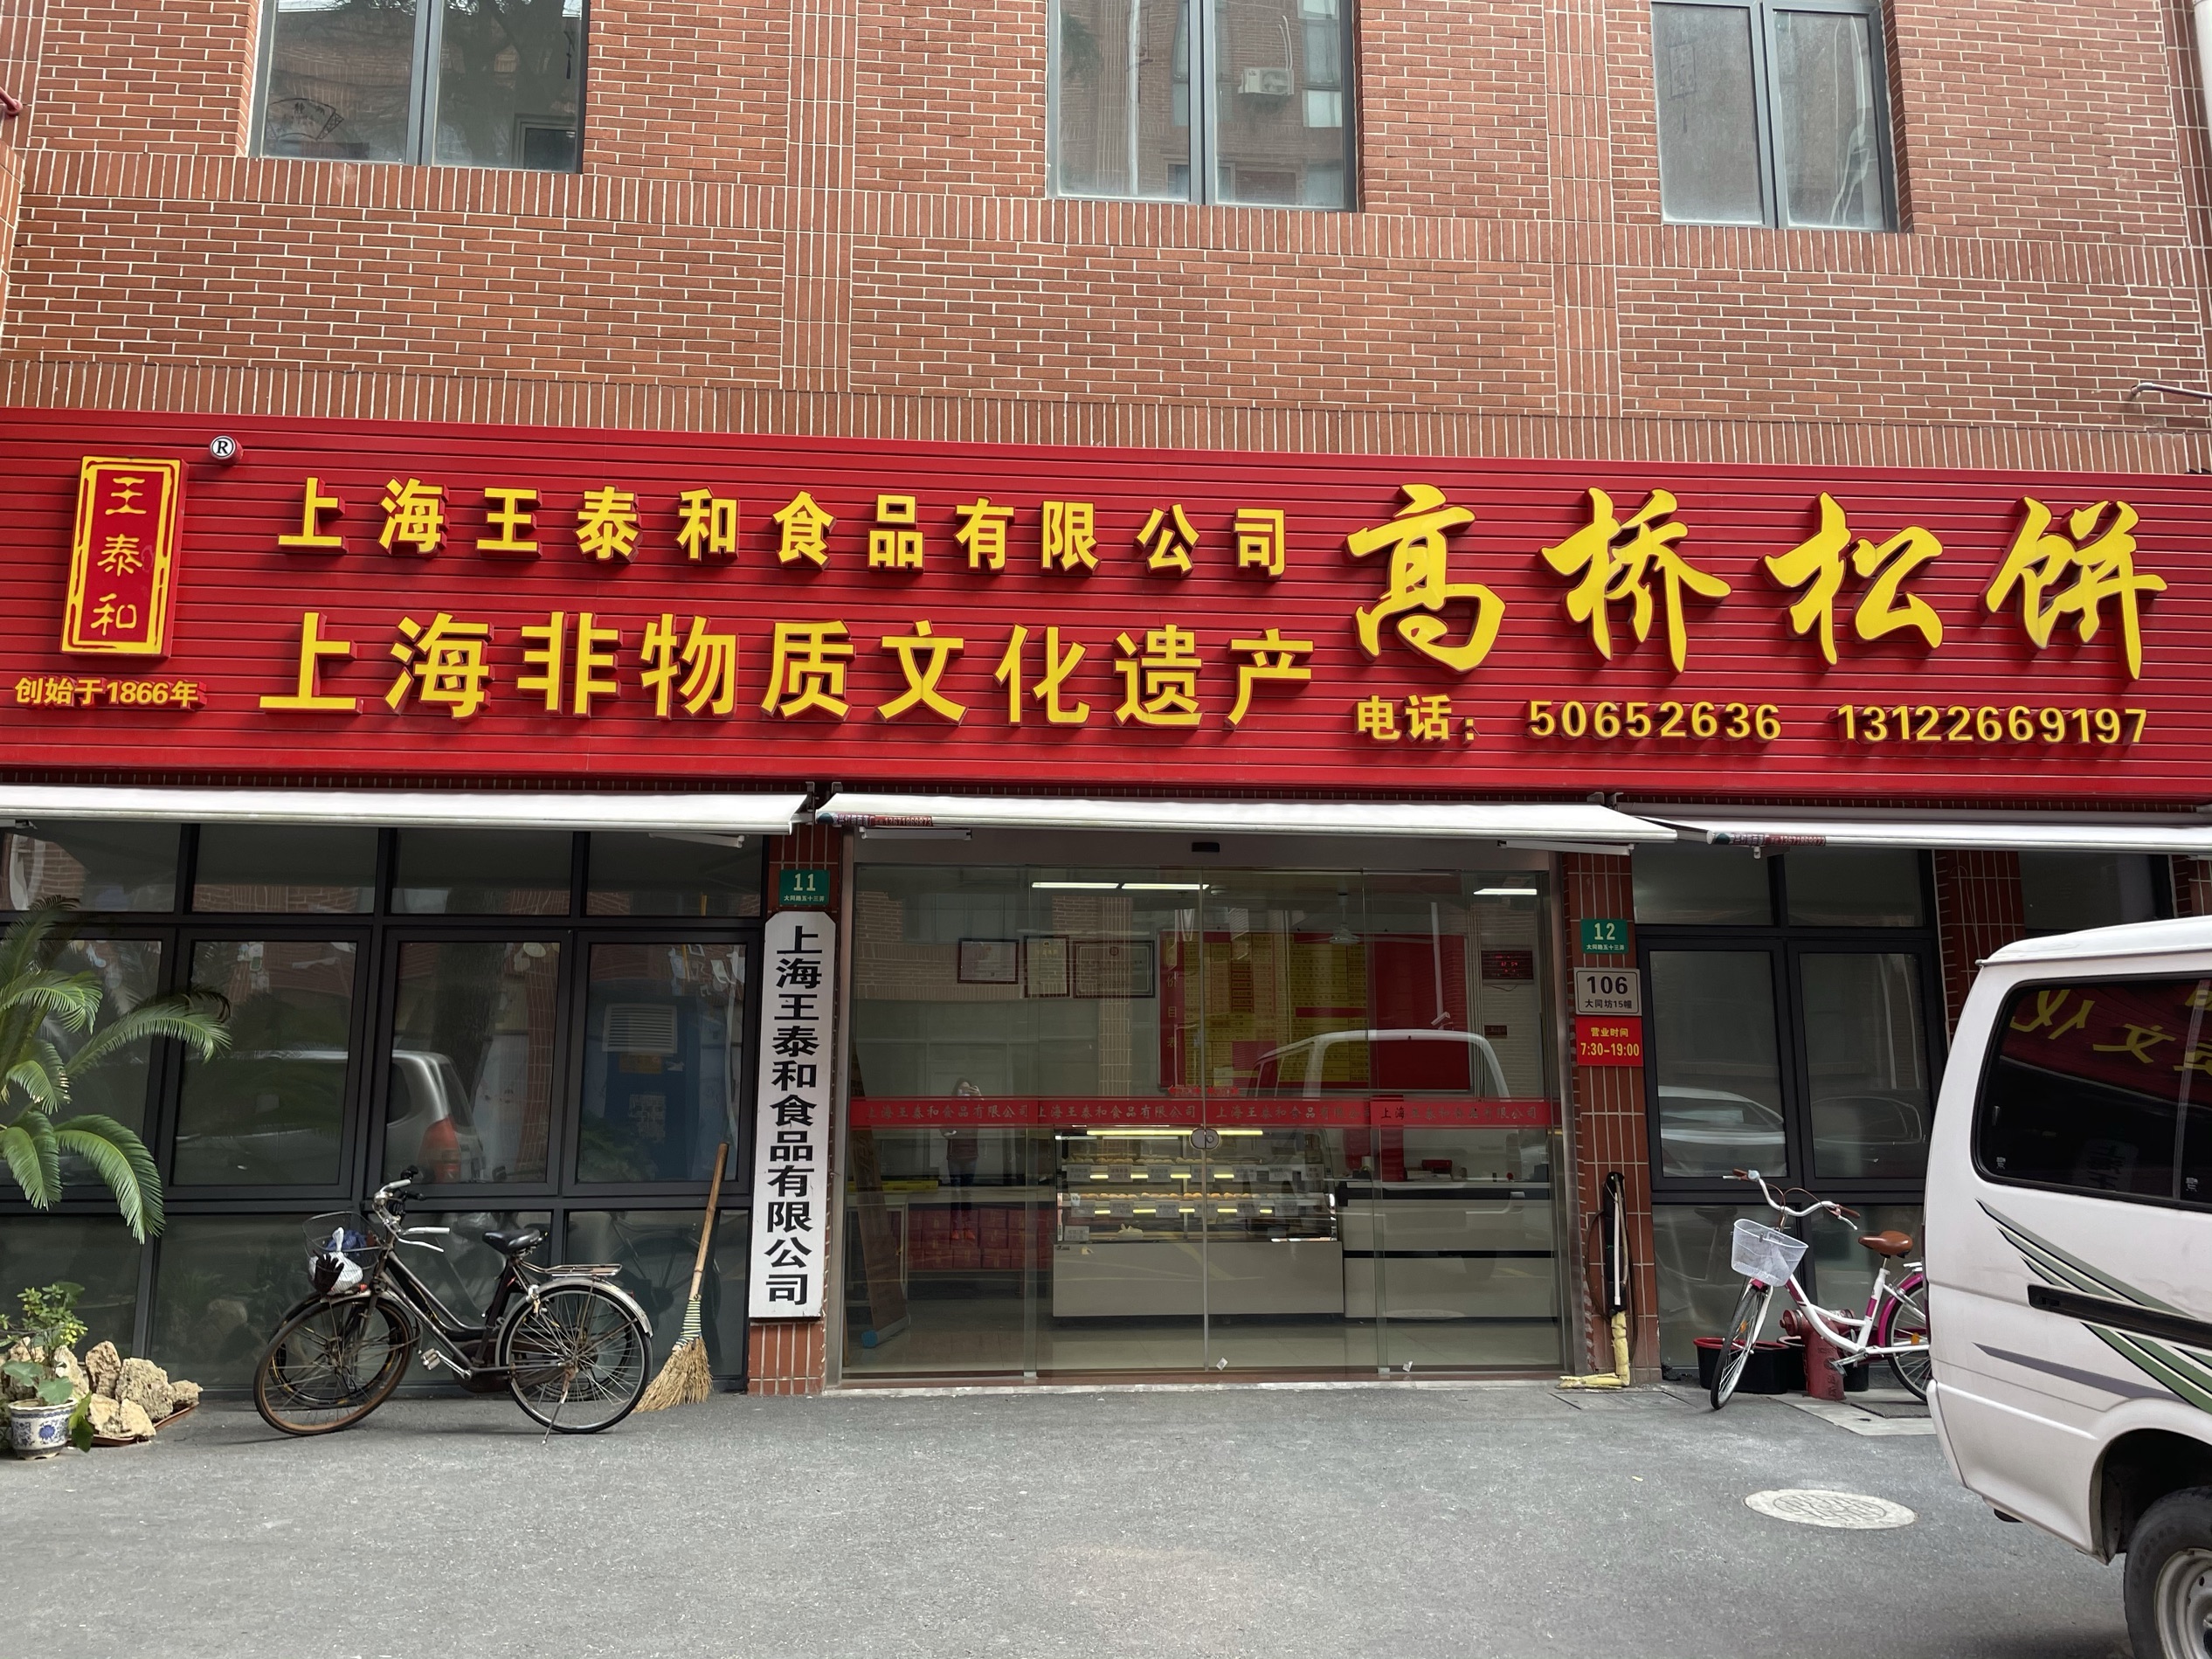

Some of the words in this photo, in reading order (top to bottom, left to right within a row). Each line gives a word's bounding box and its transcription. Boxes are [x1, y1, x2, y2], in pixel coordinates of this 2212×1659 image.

[278, 477, 1286, 578] 上海王泰和食品有限公司
[90, 476, 147, 636] 王泰和
[1346, 483, 2168, 681] 高桥松饼
[259, 612, 1314, 730] 上海非物质文化遗产
[15, 677, 199, 708] 创始于1866年
[1529, 700, 1782, 741] 50652636
[1838, 703, 2147, 744] 13122669197
[793, 873, 816, 891] 11
[1594, 923, 1615, 940] 12
[1586, 976, 1628, 994] 106
[1585, 999, 1633, 1009] 大同坊15幢
[1590, 1027, 1628, 1038] 营业时间
[1580, 1042, 1639, 1057] 7:30-19:00
[764, 925, 822, 1305] 上海王泰和食品有限公司
[868, 1104, 1028, 1119] 上海王泰和食品有限公司
[1038, 1104, 1196, 1119] 上海王泰和食品有限公司
